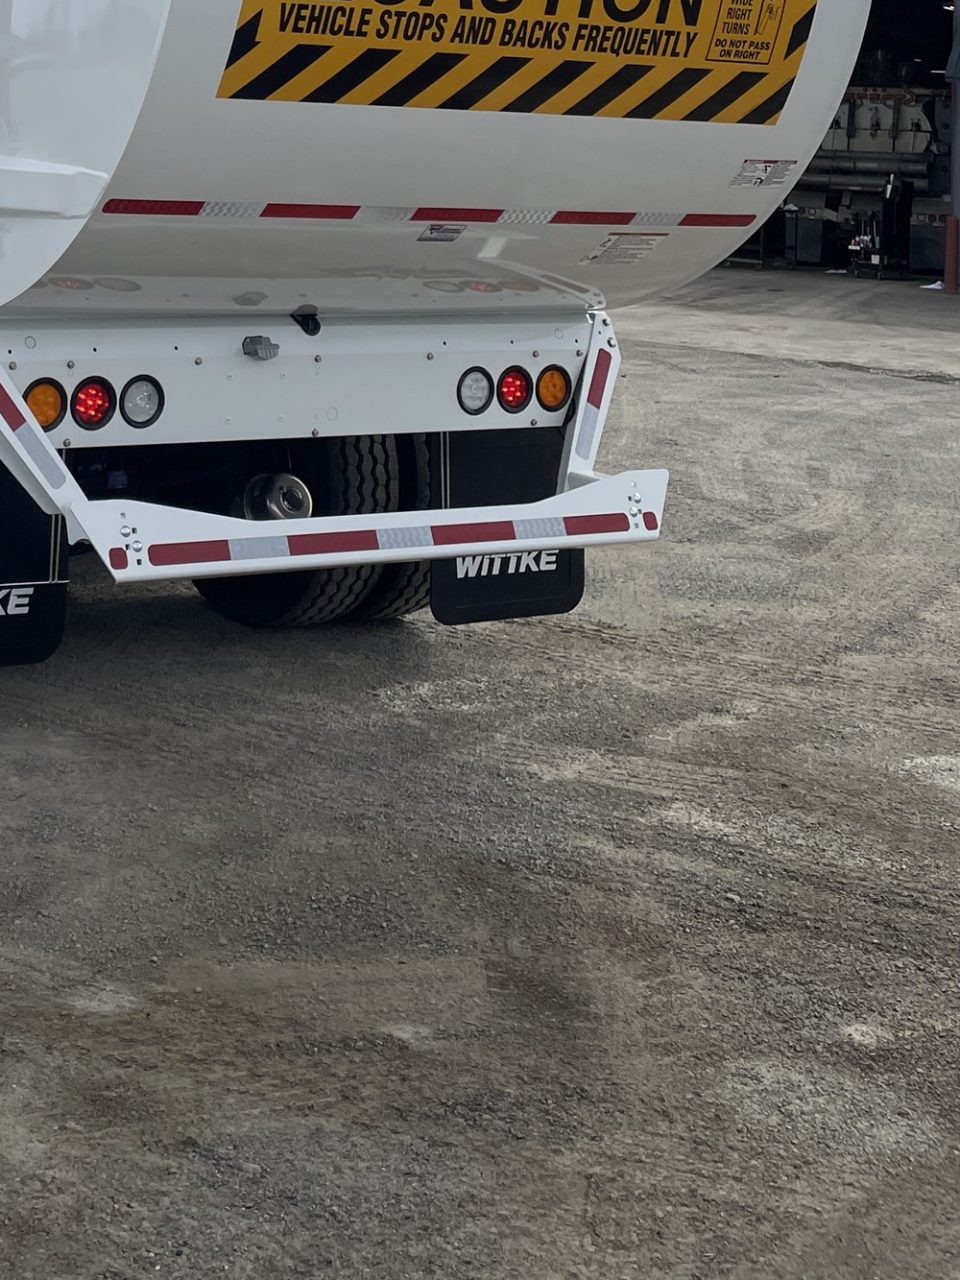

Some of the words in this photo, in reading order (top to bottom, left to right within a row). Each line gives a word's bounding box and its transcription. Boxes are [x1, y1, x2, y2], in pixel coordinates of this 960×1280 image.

[726, 7, 753, 21] RIGHT
[279, 2, 373, 37] VEHICLE
[376, 9, 448, 42] STOPS
[450, 15, 496, 45] AND
[499, 18, 570, 50] BACKS
[572, 24, 699, 58] FREQUENTLY
[721, 21, 751, 35] TURNS
[715, 38, 727, 48] DO
[728, 39, 747, 49] NOT
[748, 41, 771, 51] PASS
[719, 48, 732, 58] ON
[734, 50, 761, 60] RIGHT
[456, 549, 559, 579] WITTKE
